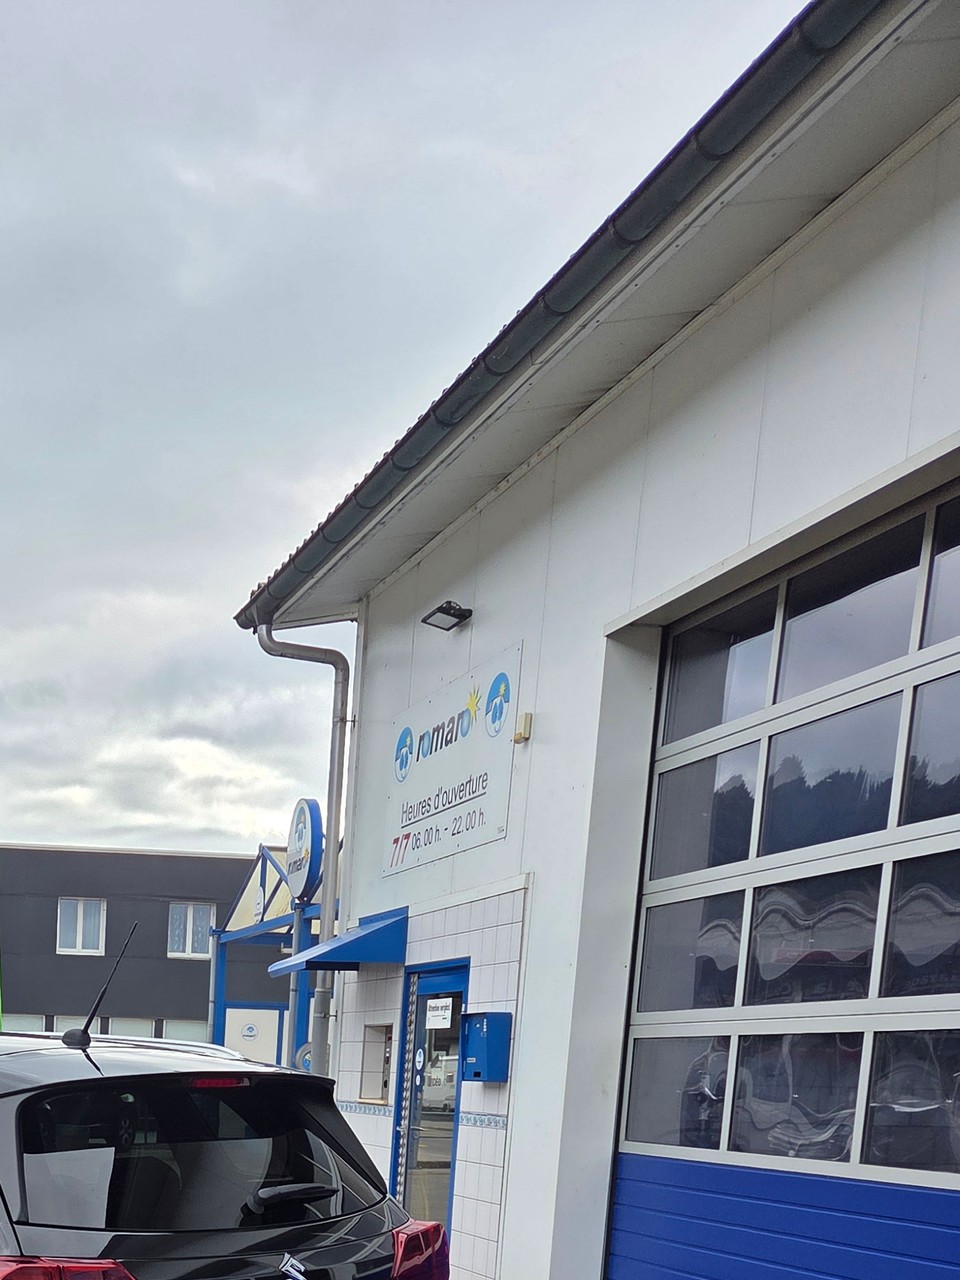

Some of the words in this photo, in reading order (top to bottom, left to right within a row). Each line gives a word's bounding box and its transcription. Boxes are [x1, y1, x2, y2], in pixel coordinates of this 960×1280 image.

[416, 707, 472, 763] romaro
[401, 797, 431, 824] Heures
[434, 772, 489, 811] d'ouverture
[390, 832, 411, 868] 7/7
